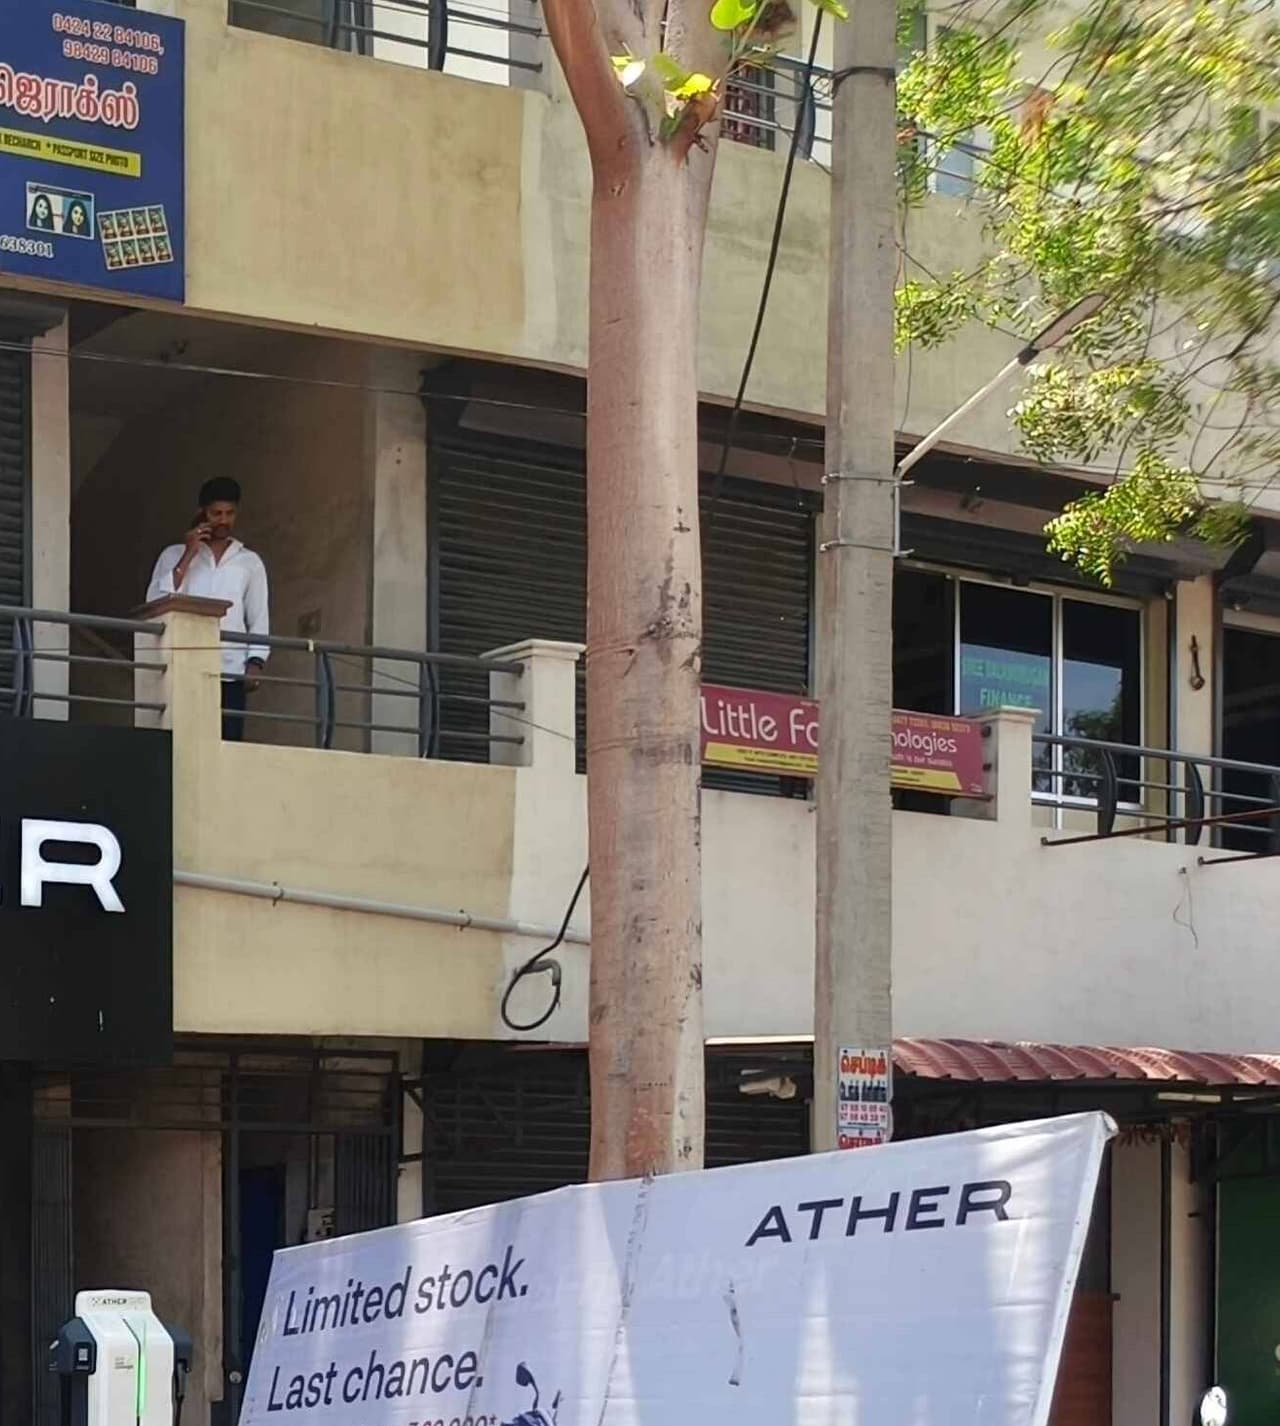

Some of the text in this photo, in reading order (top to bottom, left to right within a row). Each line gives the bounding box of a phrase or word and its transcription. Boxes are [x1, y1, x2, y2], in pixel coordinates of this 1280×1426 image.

[52, 13, 90, 38] 0424
[92, 22, 112, 43] 22
[700, 695, 779, 742] Little
[745, 1179, 1014, 1247] ATHER
[282, 1245, 529, 1337] Limited stock.
[267, 1350, 484, 1412] Last chance.
